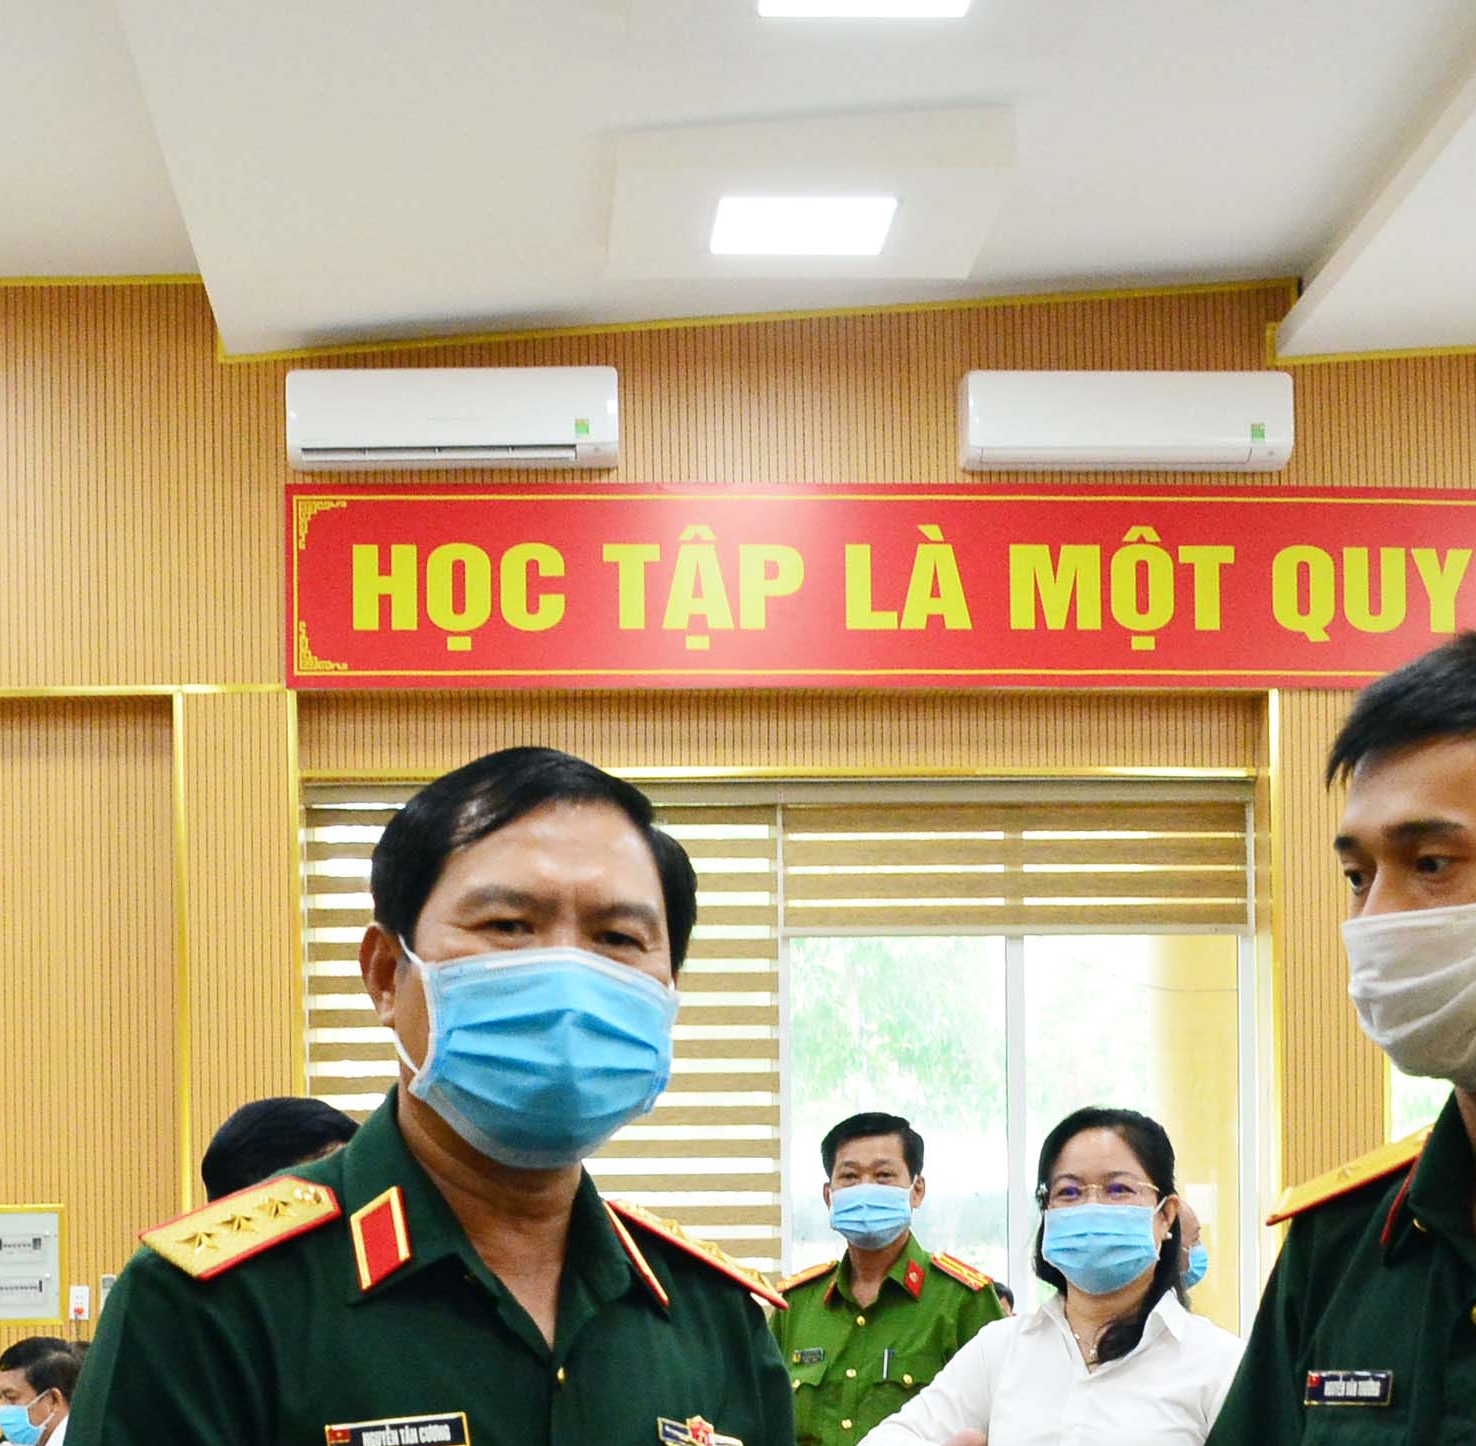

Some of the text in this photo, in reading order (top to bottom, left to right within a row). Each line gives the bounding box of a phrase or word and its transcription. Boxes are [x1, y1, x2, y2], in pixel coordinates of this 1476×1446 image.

[352, 542, 566, 651] HỌC
[602, 525, 805, 650] TẬP
[844, 524, 973, 631] LÀ
[1009, 526, 1236, 651] MỘT
